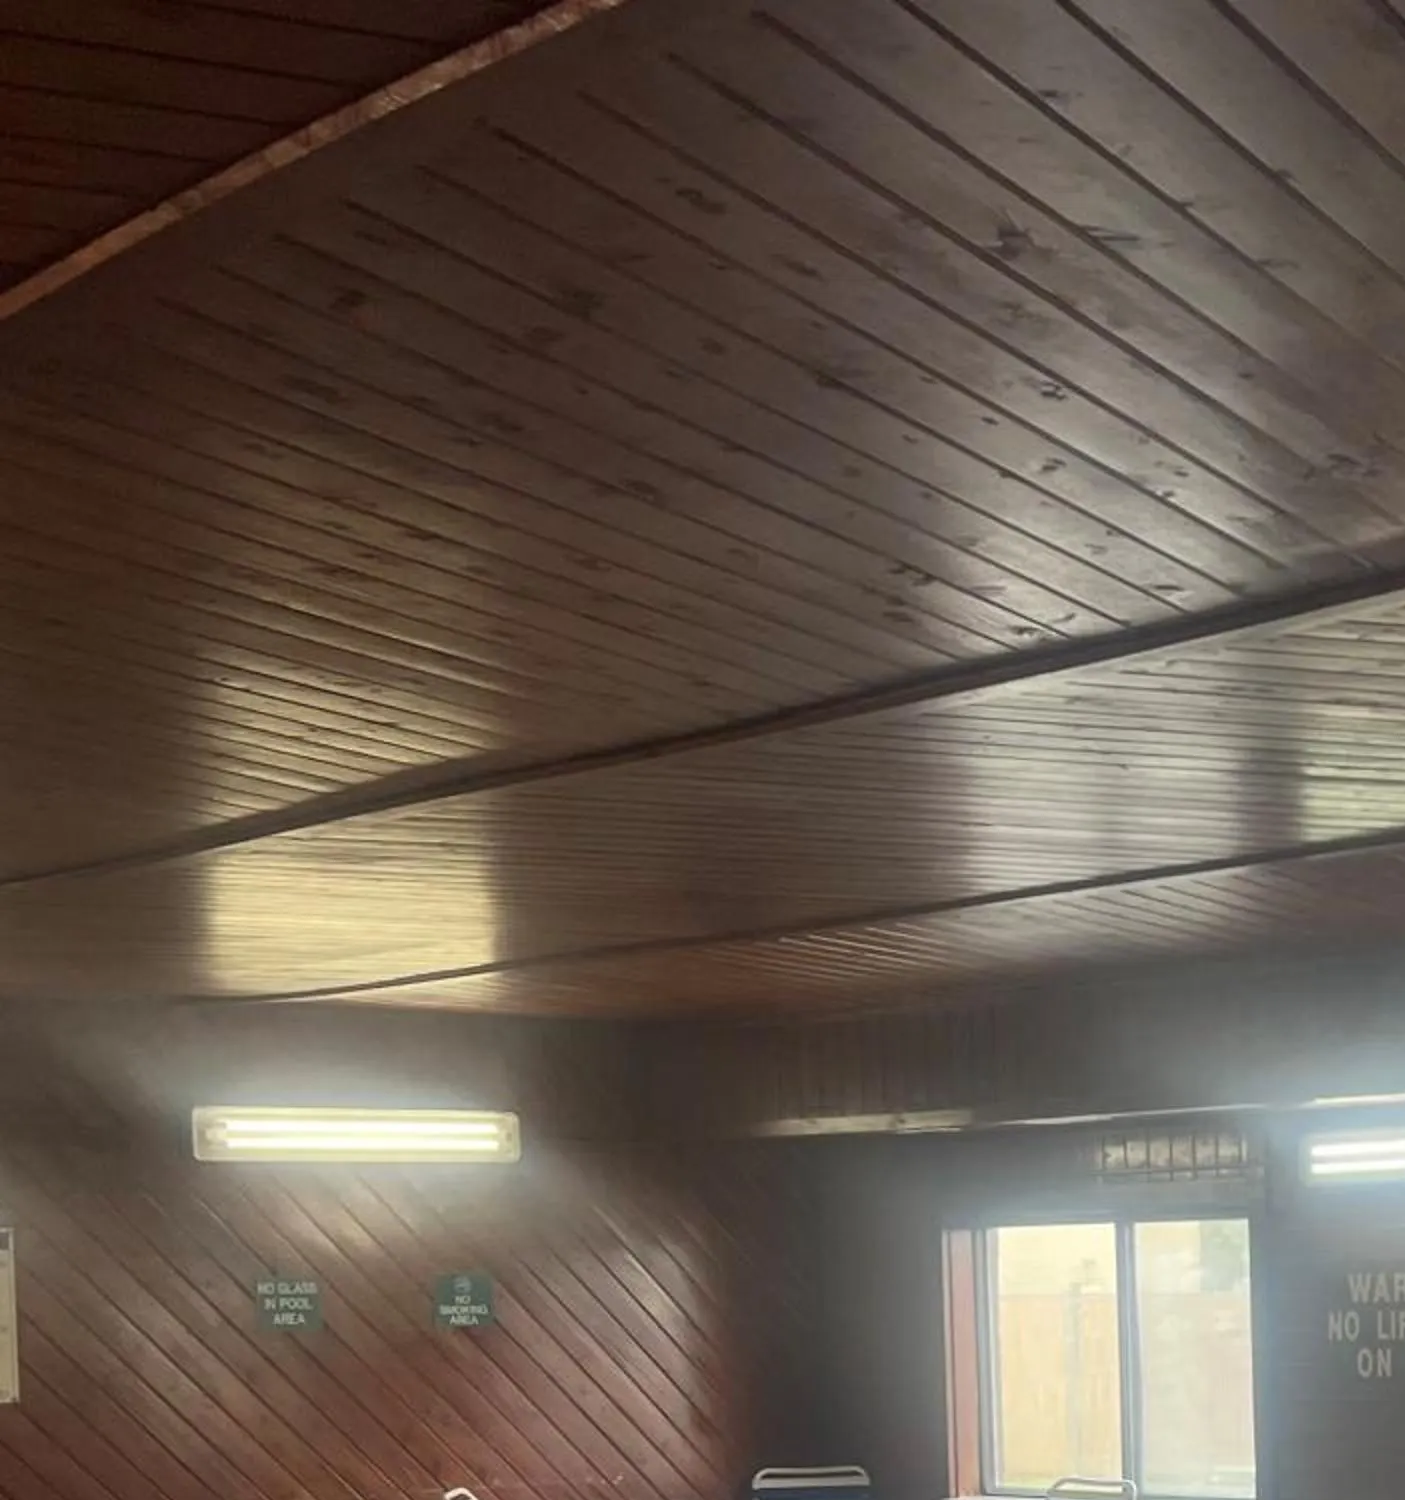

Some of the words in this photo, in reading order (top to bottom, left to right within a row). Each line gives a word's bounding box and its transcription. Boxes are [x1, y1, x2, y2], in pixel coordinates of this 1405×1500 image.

[257, 1282, 275, 1295] NO
[277, 1281, 318, 1295] GLASS
[264, 1297, 276, 1311] IN
[279, 1297, 313, 1311] POOL
[455, 1295, 472, 1305] NO
[440, 1305, 489, 1316] SMOKING
[272, 1312, 305, 1325] AREA
[449, 1315, 479, 1326] AREA
[1327, 1310, 1361, 1342] NO
[1357, 1348, 1393, 1379] ON
